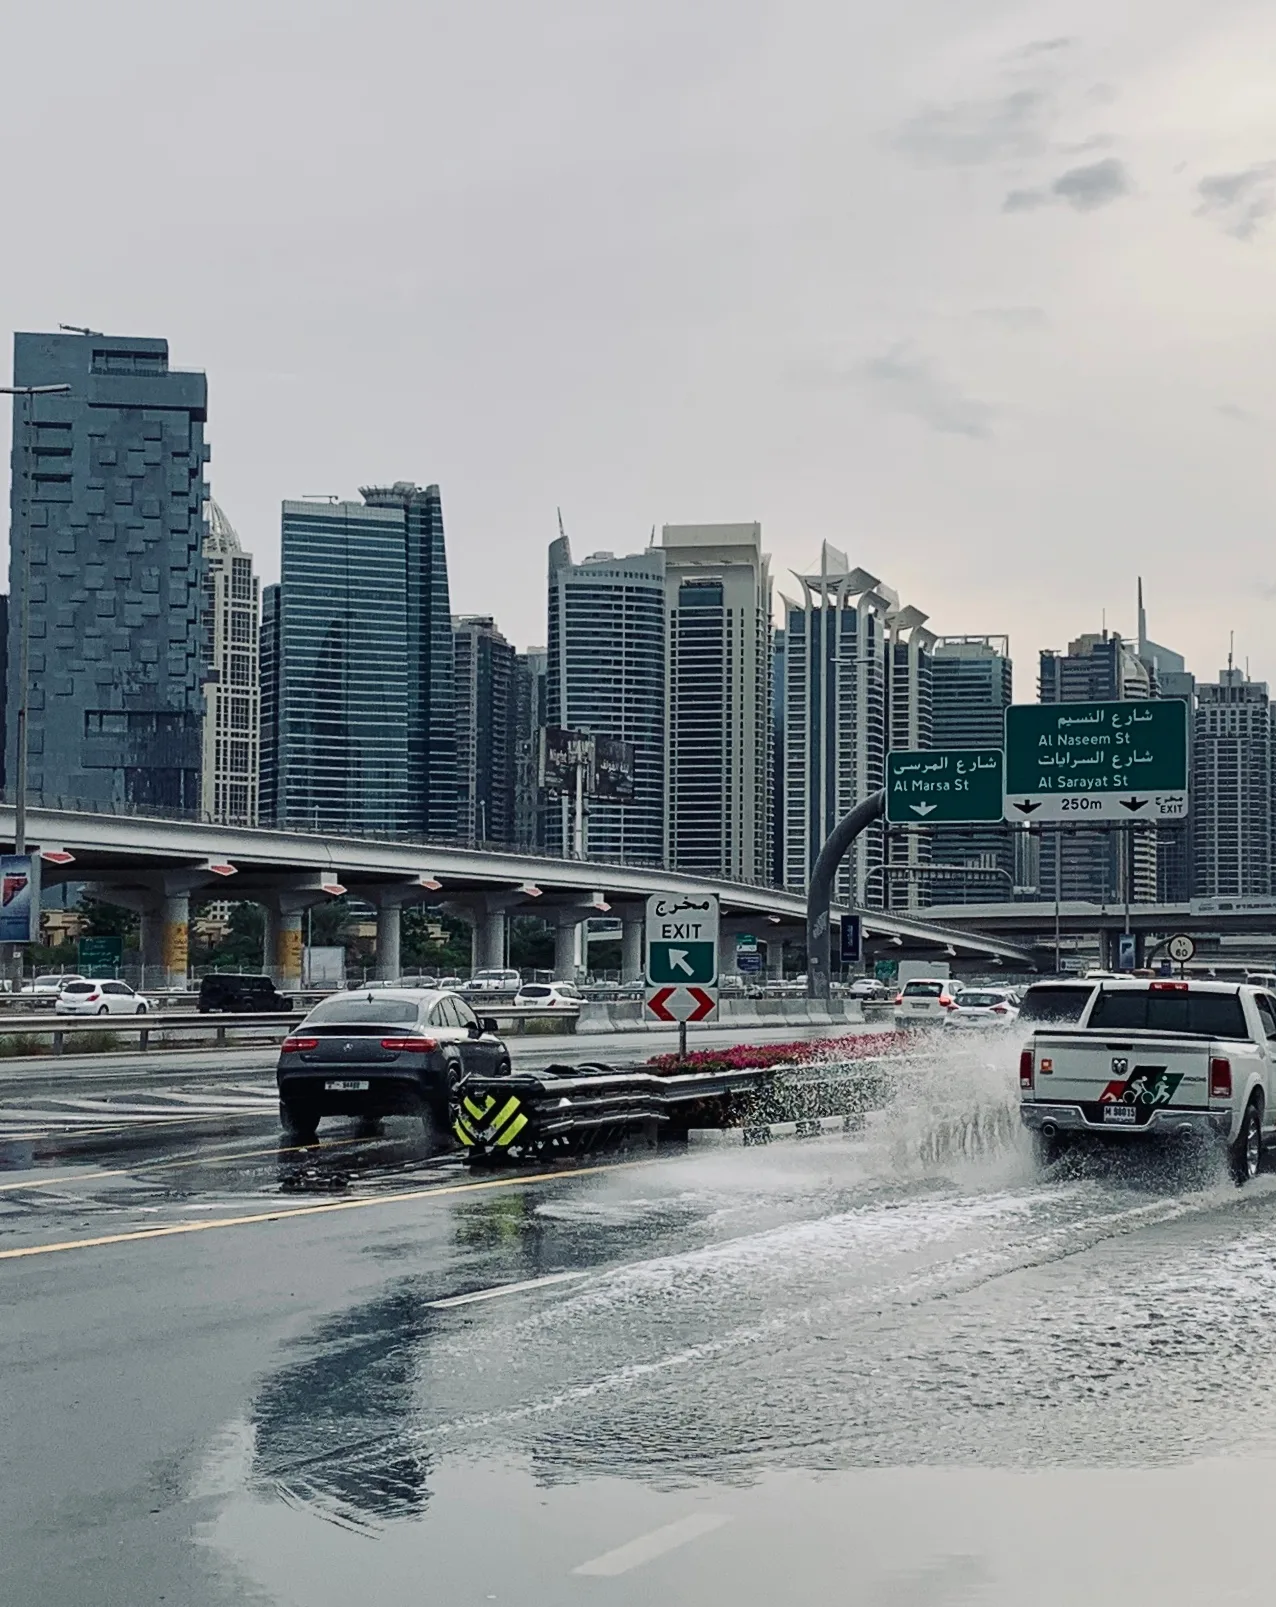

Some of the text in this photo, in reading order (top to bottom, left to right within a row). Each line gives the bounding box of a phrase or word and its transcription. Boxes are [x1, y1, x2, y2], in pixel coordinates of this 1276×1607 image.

[1057, 708, 1153, 729] شارع النسيم
[1038, 732, 1131, 747] Al Naseem St
[893, 755, 997, 775] شارع المرسى
[1038, 749, 1153, 769] شارع السرايات
[893, 778, 969, 792] Al Marsa St
[1038, 774, 1129, 790] Al Sarayat St
[1061, 798, 1103, 811] 250m
[1160, 804, 1184, 814] EXIT
[655, 896, 710, 917] مخرج
[661, 923, 702, 939] EXIT
[1175, 948, 1188, 957] 60
